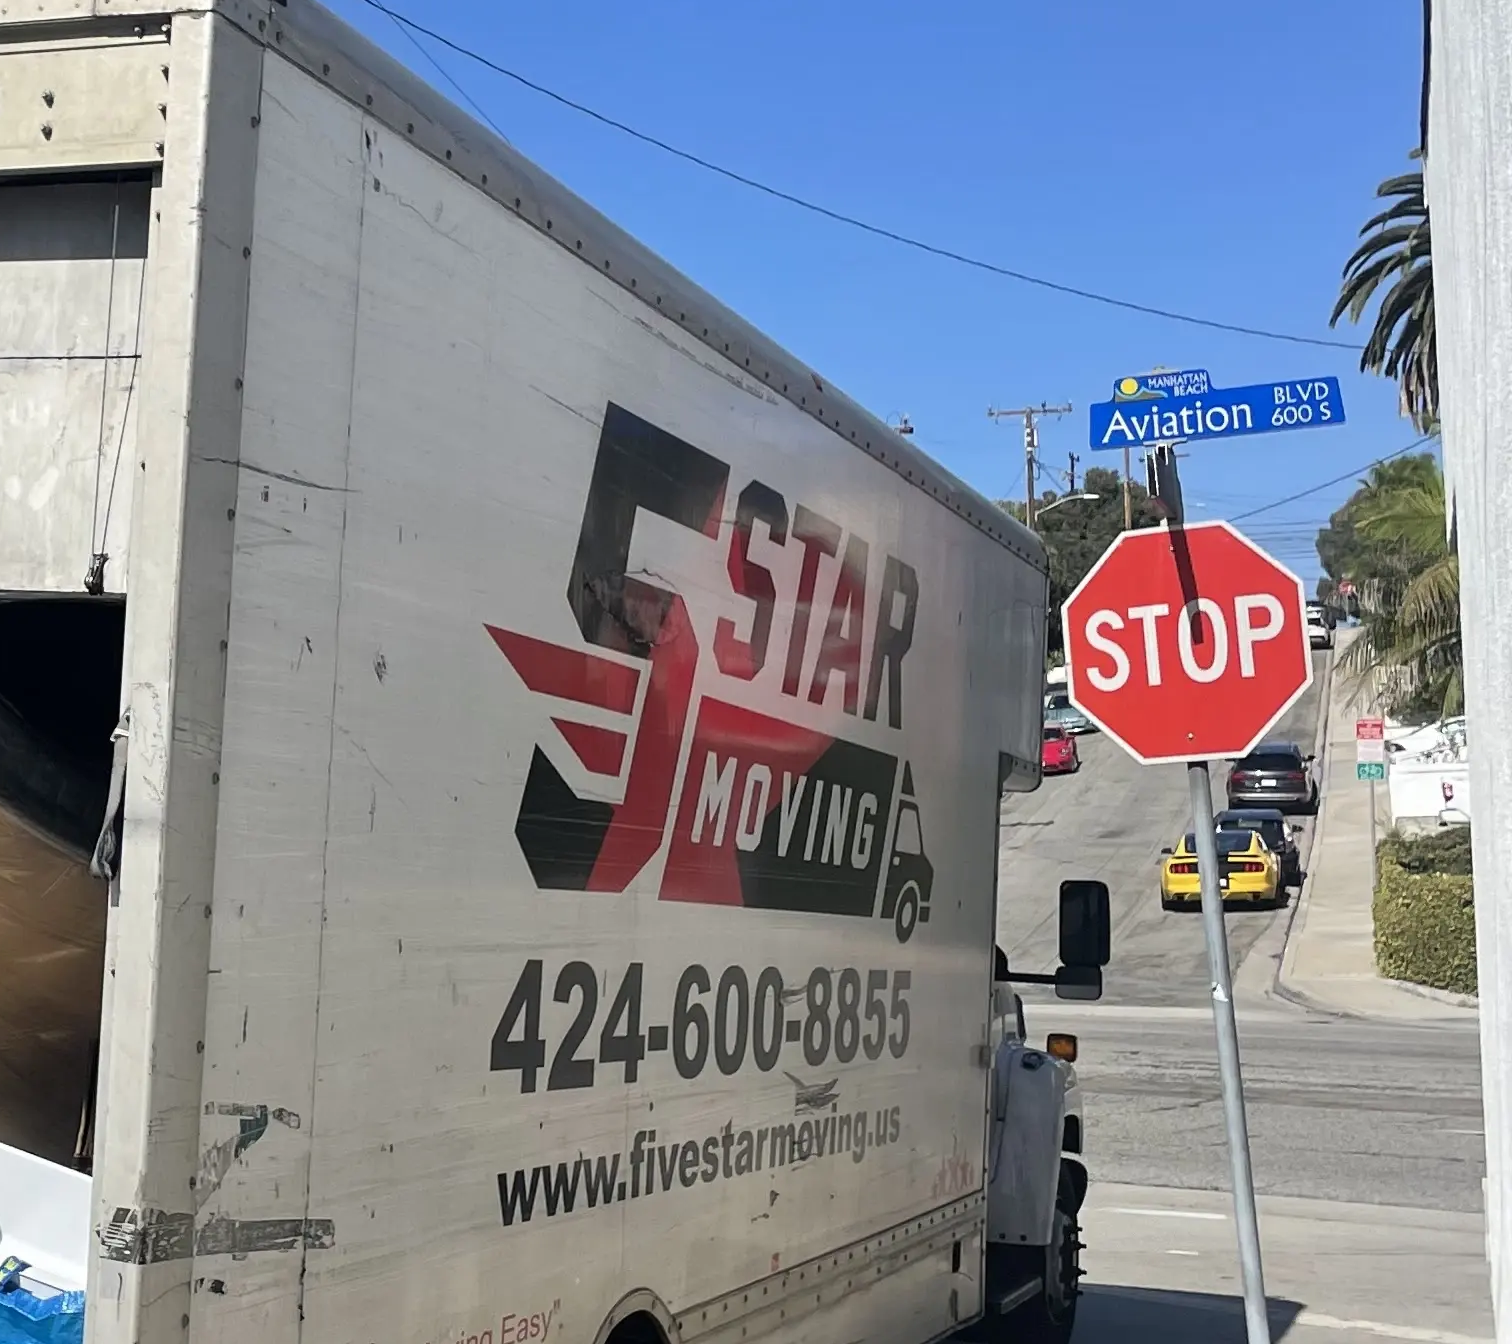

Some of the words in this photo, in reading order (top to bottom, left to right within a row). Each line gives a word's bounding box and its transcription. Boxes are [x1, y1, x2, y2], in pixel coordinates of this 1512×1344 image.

[1147, 372, 1207, 389] MANHATTAN
[1174, 382, 1208, 397] BEACH
[1271, 405, 1313, 427] 600
[1321, 401, 1332, 421] S
[1274, 382, 1329, 405] BLVD
[1101, 400, 1253, 444] Aviation
[712, 478, 919, 731] STAR
[1084, 593, 1286, 693] STOP
[690, 750, 879, 870] MOVING
[489, 959, 912, 1095] 424-600-8855
[497, 1102, 901, 1227] www.fivestarmoving.us
